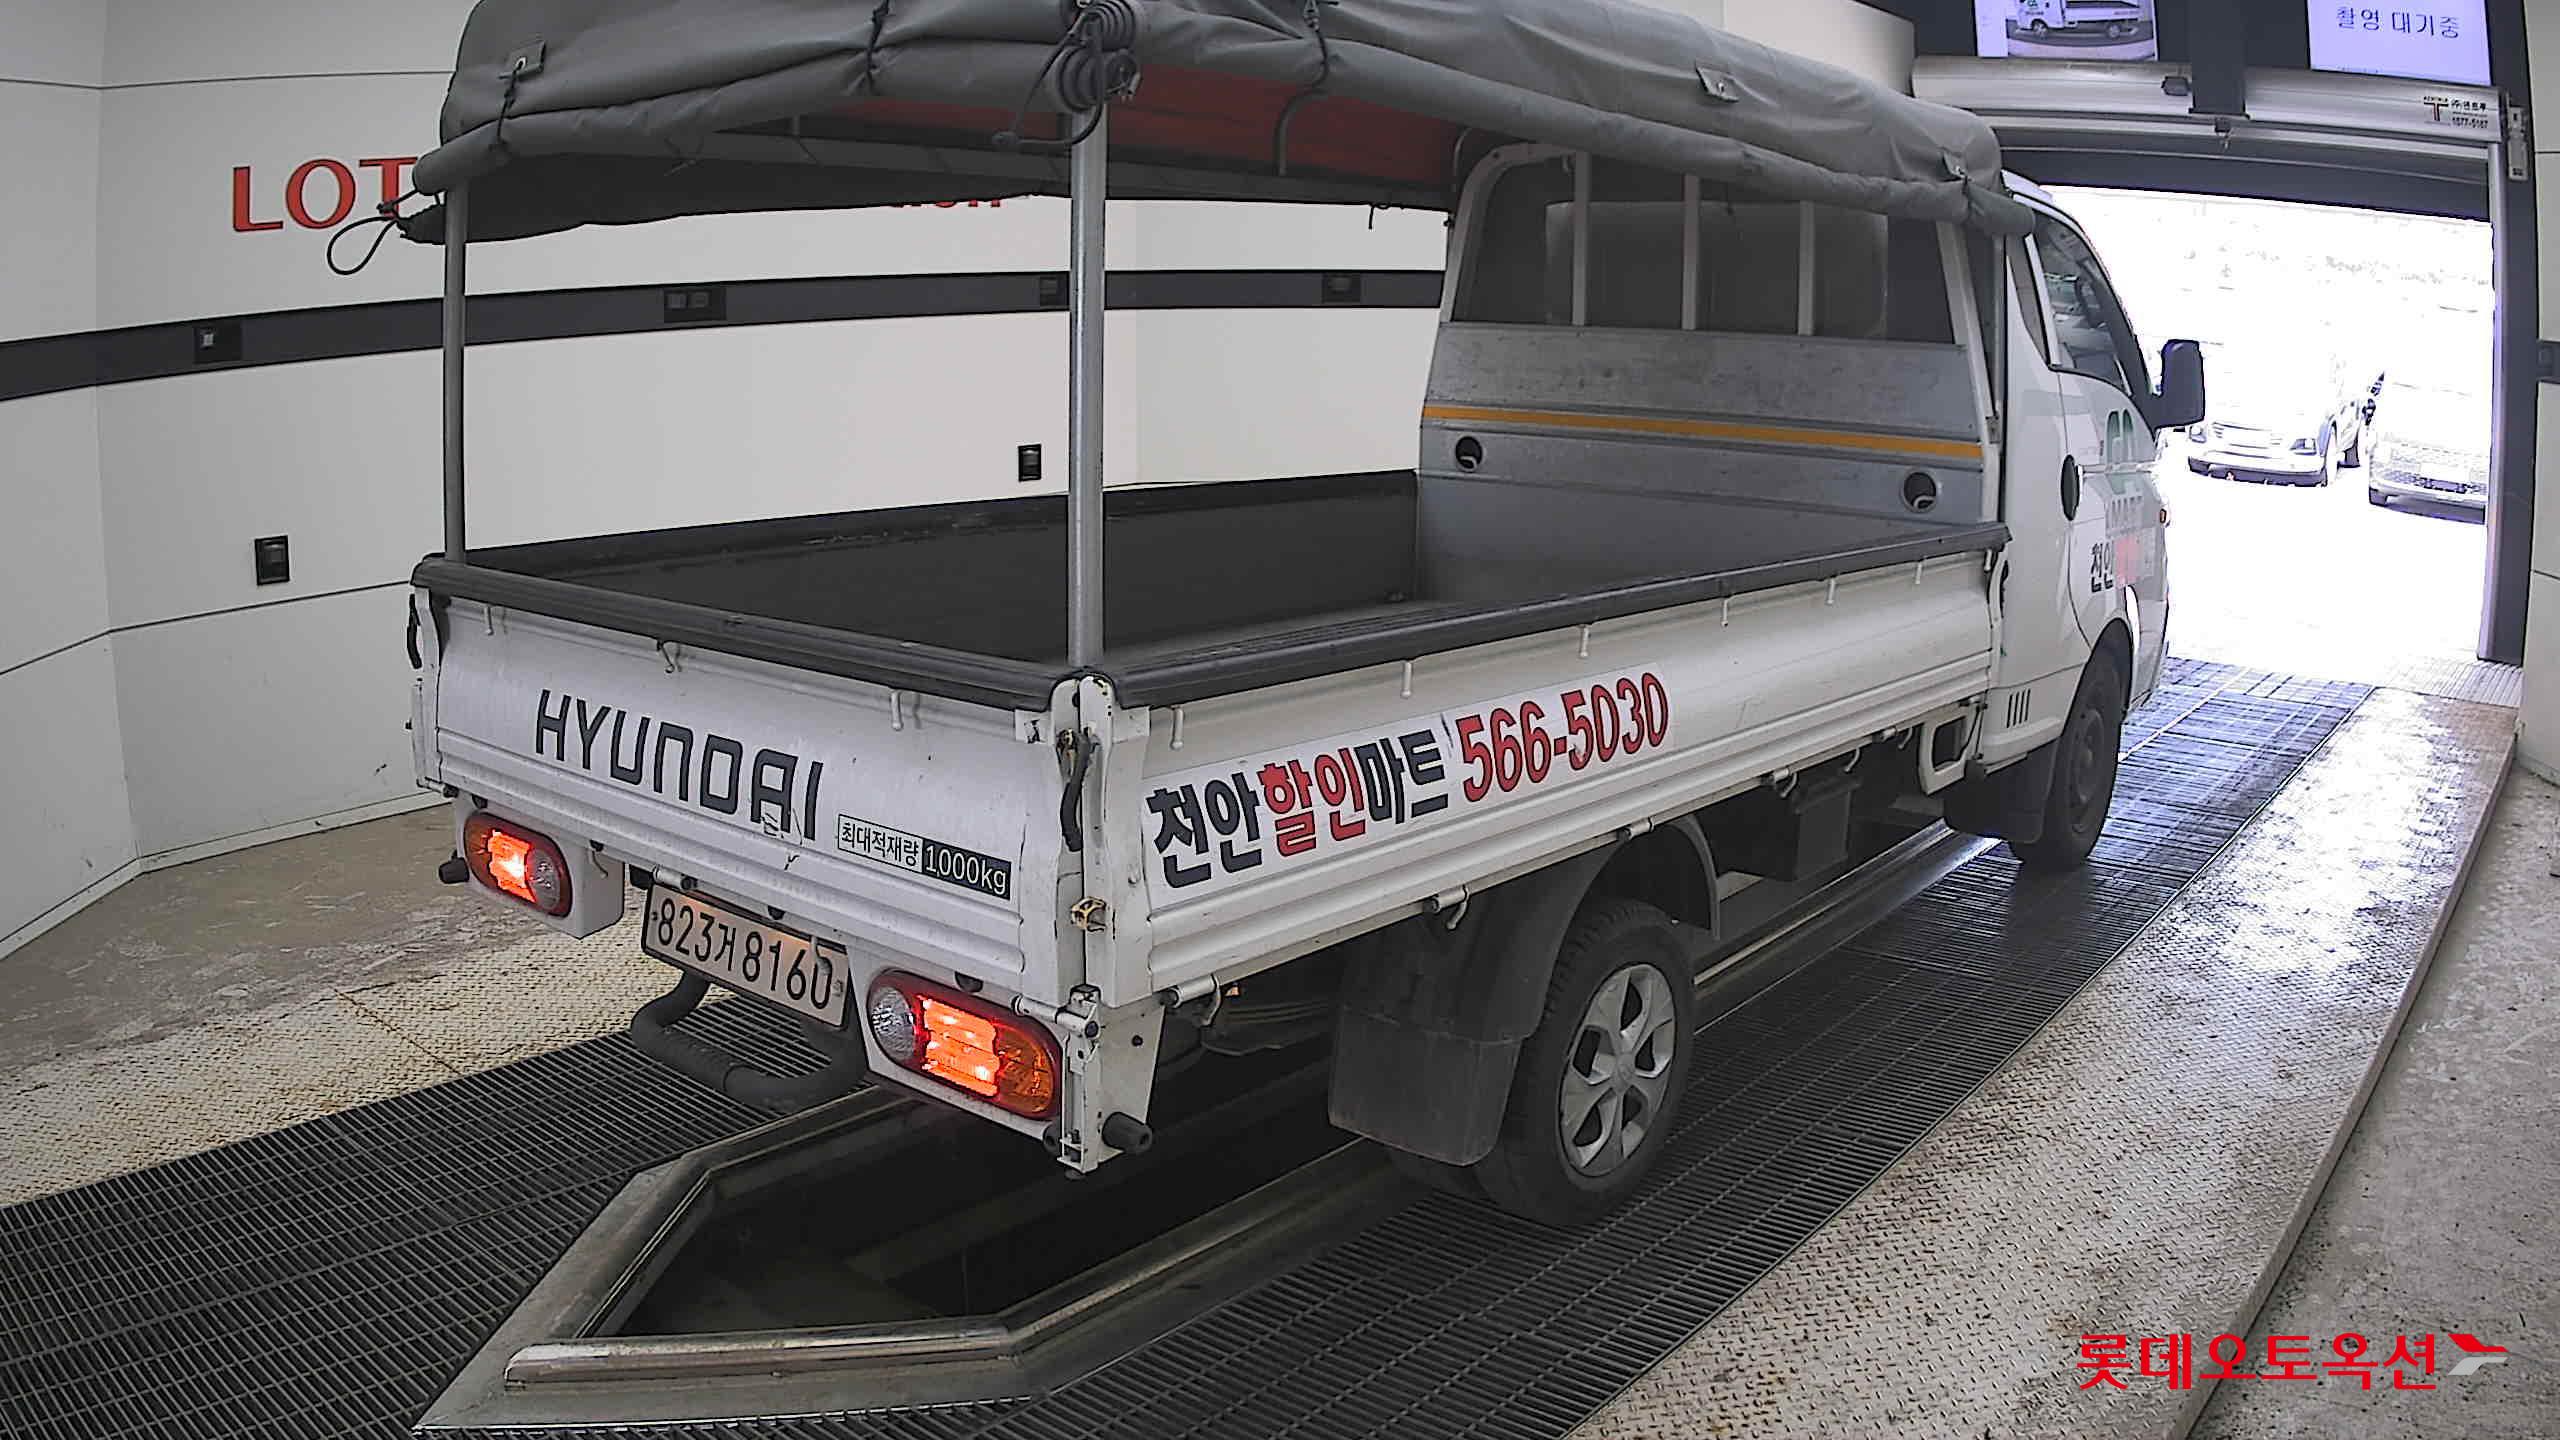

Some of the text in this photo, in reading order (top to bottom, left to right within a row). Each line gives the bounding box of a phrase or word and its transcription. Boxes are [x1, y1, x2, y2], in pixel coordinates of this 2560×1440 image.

[2391, 12, 2459, 39] 대기중
[233, 156, 418, 232] LOT
[535, 689, 824, 841] HYUNDAI
[1456, 672, 1669, 802] 566-5030
[841, 822, 919, 867] 최대적재량
